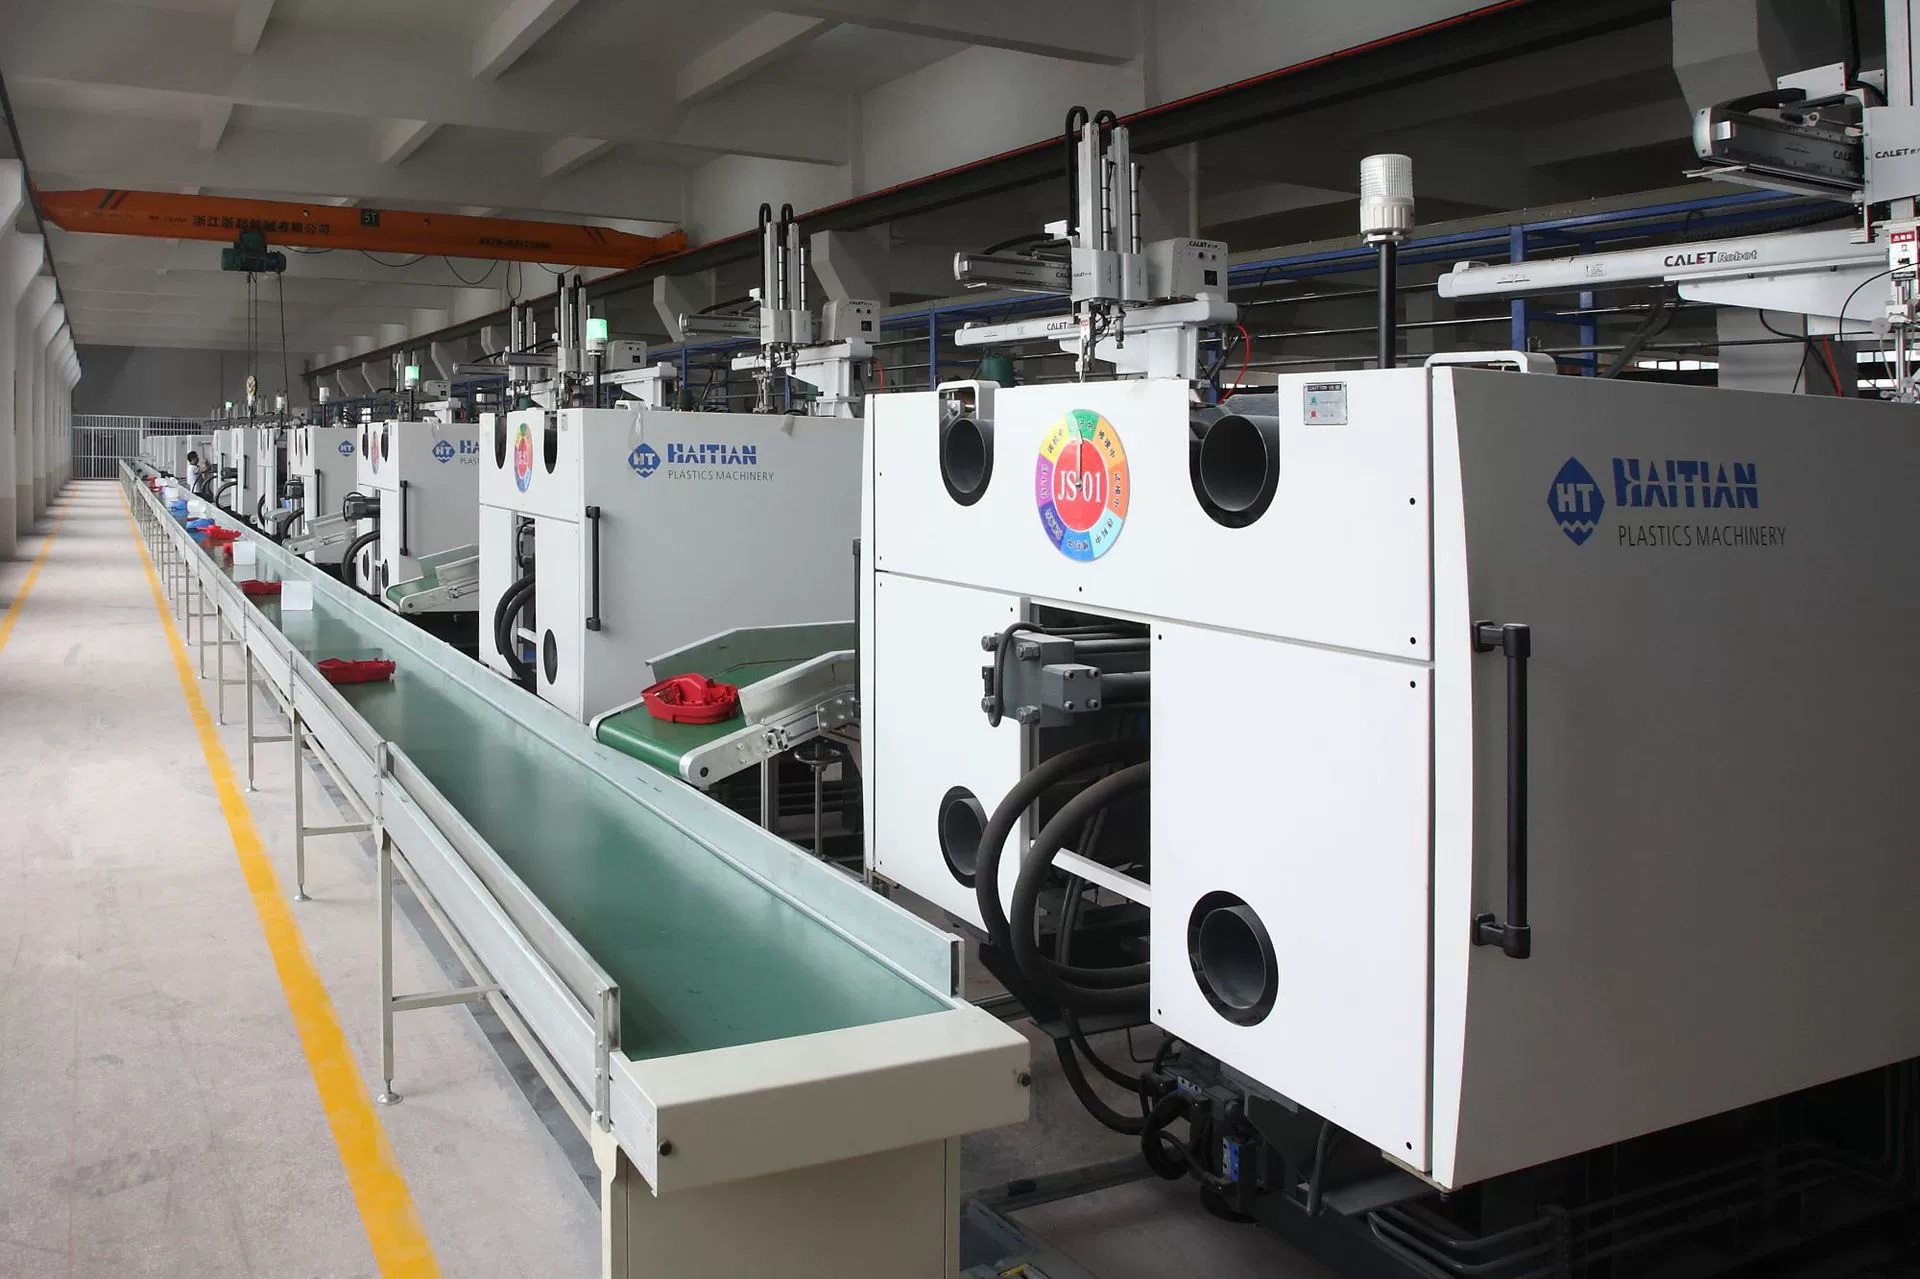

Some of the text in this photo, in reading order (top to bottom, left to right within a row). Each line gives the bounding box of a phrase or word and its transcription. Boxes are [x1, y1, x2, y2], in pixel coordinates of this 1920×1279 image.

[1875, 148, 1909, 159] CALET
[1664, 249, 1758, 267] CALET Robot
[1046, 322, 1068, 331] CALET
[634, 453, 656, 465] HT
[667, 443, 757, 465] HAITIAN
[668, 470, 775, 482] PLASTICS MACHINERY
[1611, 457, 1759, 509] HAITIAN
[1057, 470, 1102, 504] JS01
[1555, 483, 1595, 513] HT
[1617, 524, 1787, 548] PLASTICS MACHINERY
